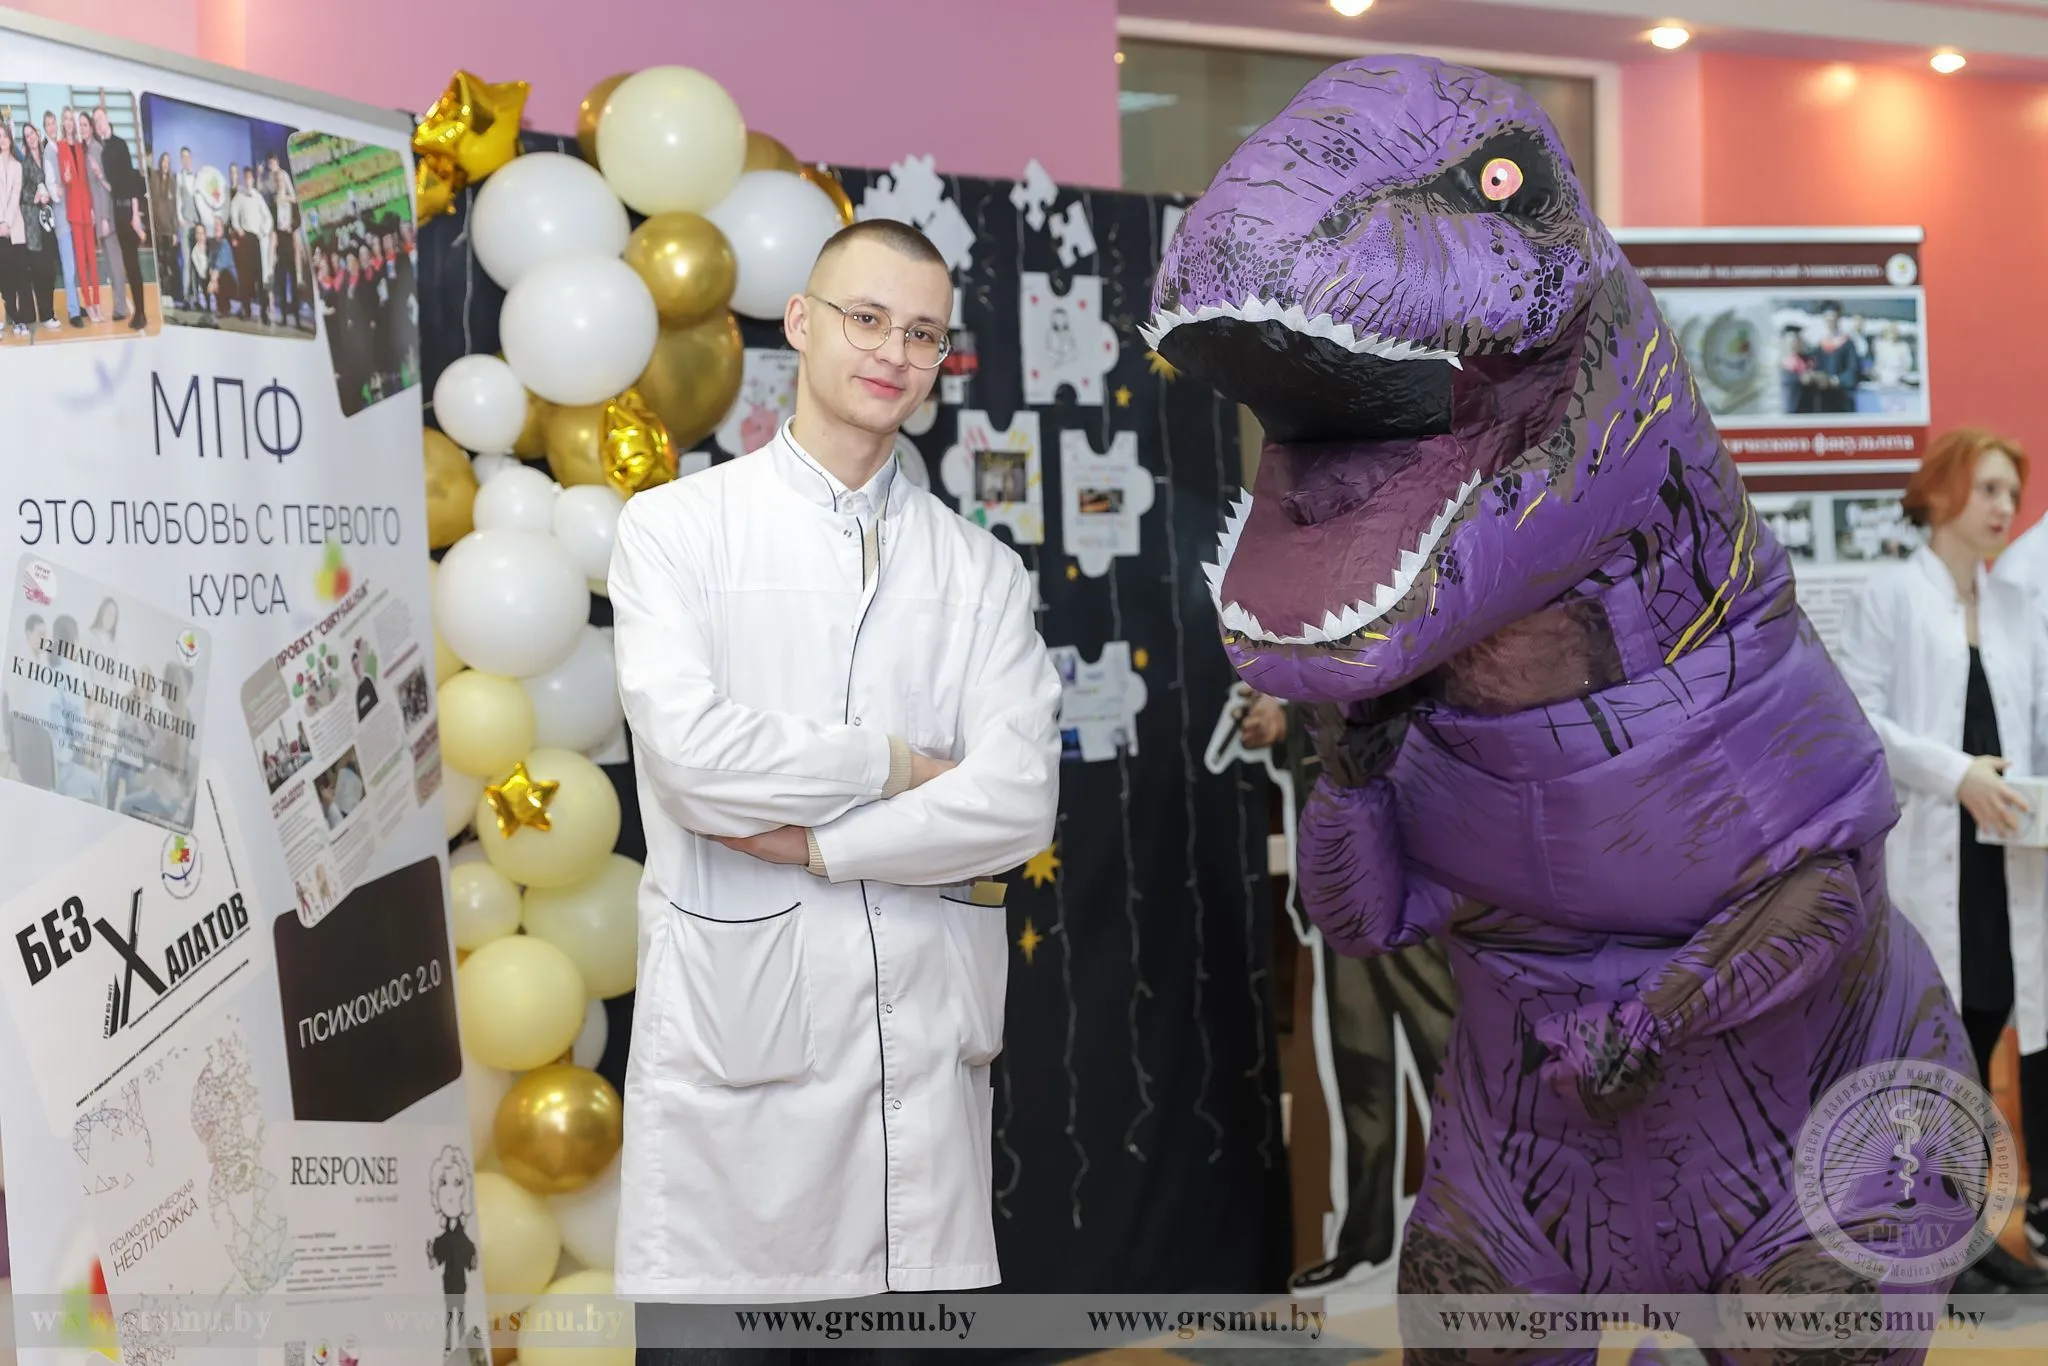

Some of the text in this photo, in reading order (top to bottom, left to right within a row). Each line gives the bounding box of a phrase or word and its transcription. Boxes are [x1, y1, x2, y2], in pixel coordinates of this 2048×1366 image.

[150, 371, 303, 463] МПФ
[19, 499, 400, 547] ЭТО ЛЮБОВЬ С ПЕРВОГО
[188, 573, 290, 617] КУРСА
[39, 637, 179, 703] 12 ШАГОВ НА ПУТИ
[274, 630, 315, 671] ПРОЕКТ
[12, 656, 23, 676] К
[28, 662, 142, 719] НОРМАЛЬНОЙ
[144, 704, 197, 741] ЖИЗНИ
[15, 895, 92, 987] БЕЗ
[298, 973, 414, 1049] ПСИХОХАОС
[416, 959, 442, 994] 2.0
[291, 1156, 399, 1186] RESPONSE
[113, 1197, 199, 1277] НЕОТЛОЖКА
